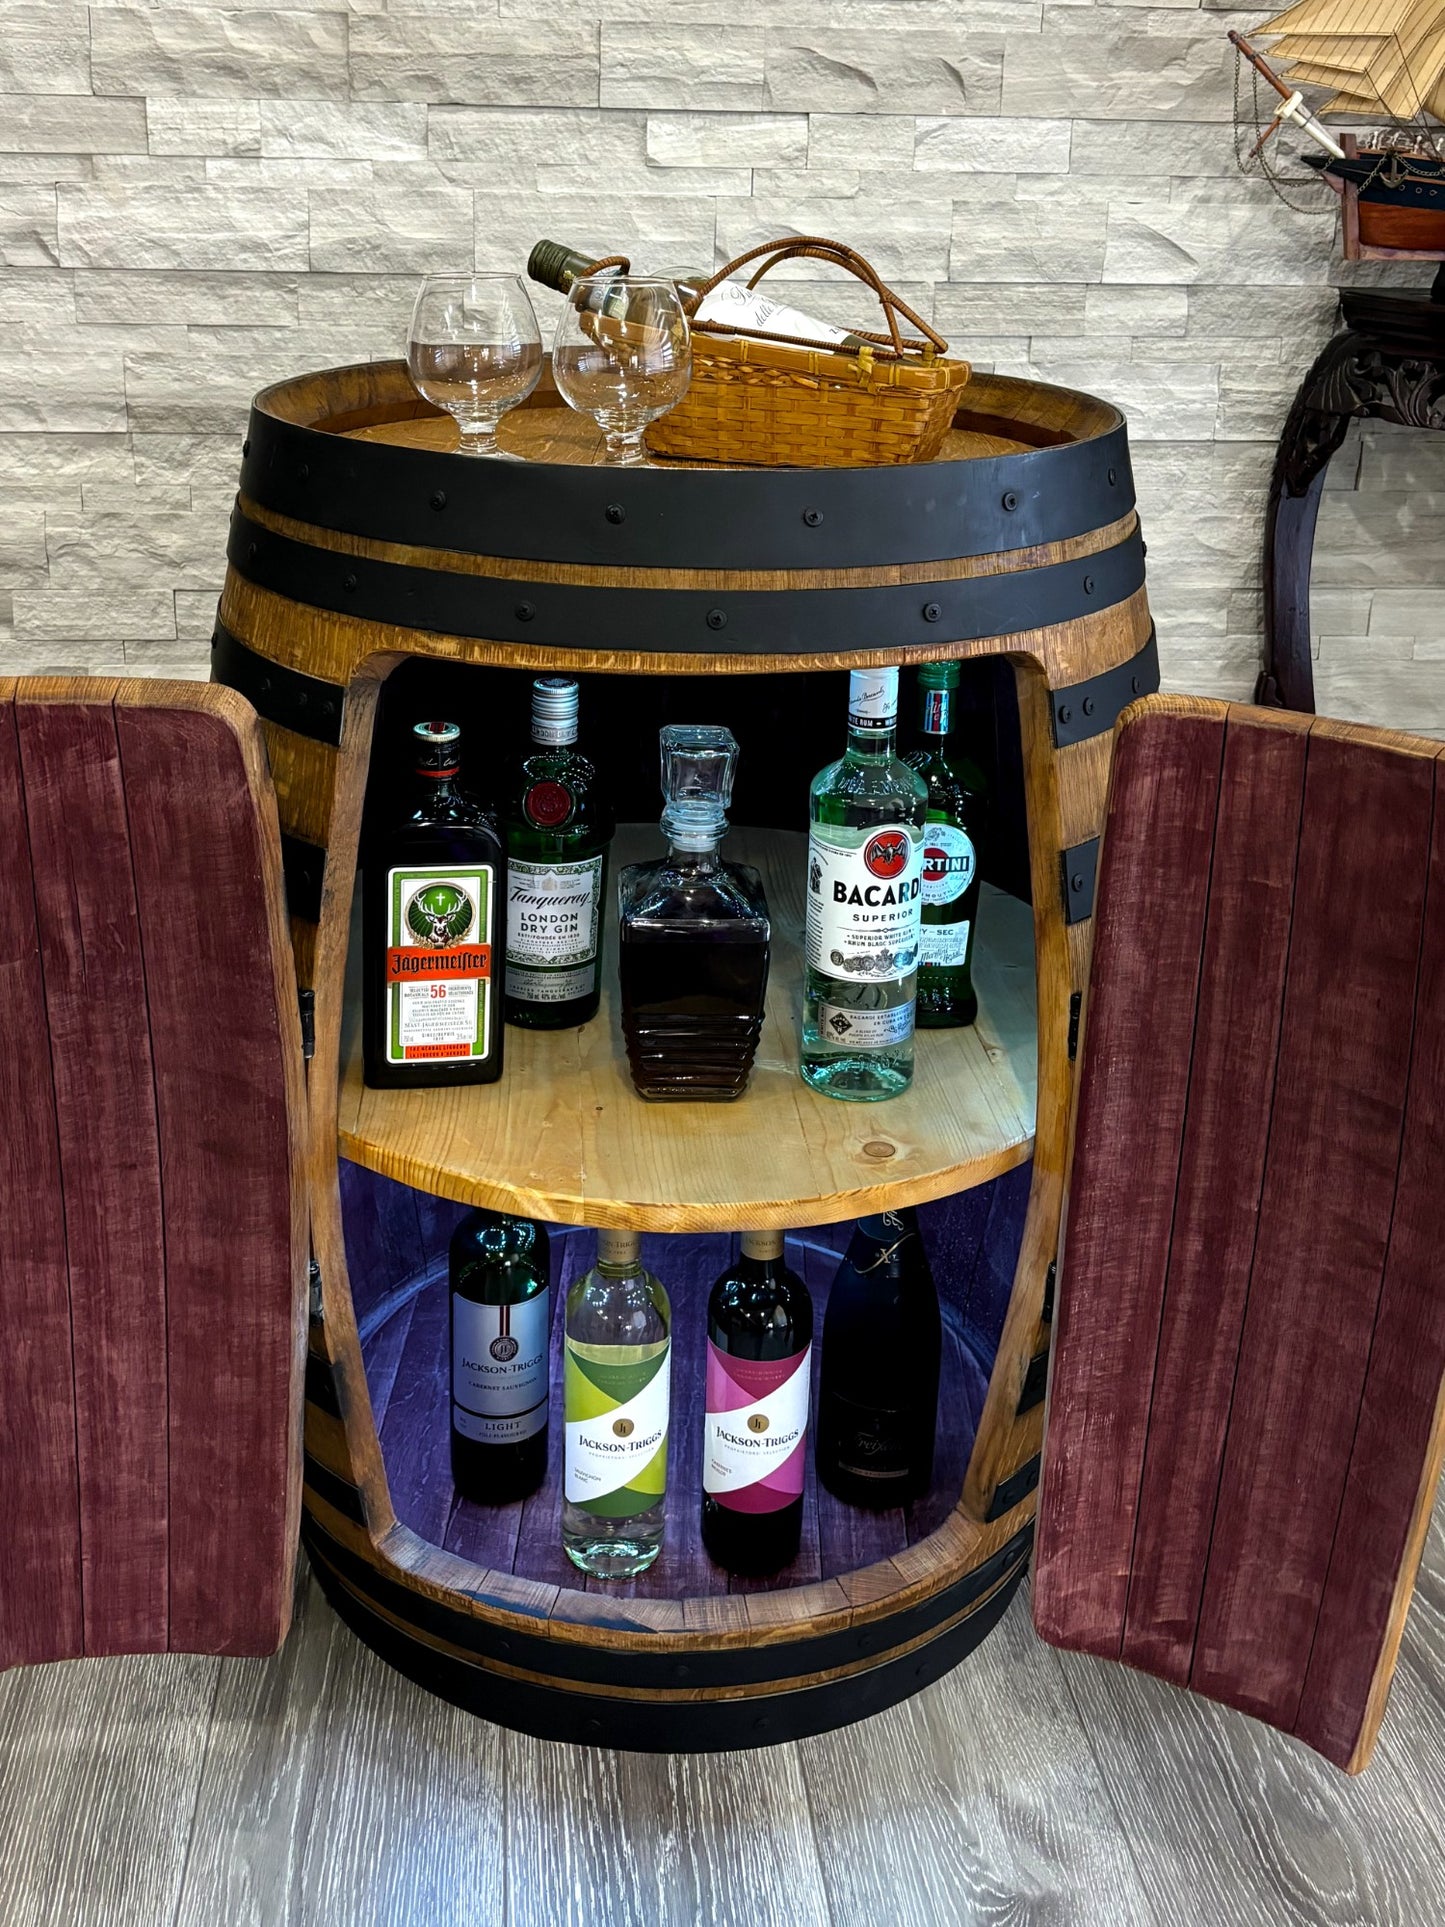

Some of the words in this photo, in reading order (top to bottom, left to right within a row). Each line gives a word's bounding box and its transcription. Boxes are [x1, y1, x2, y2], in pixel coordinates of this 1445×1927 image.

[924, 857, 967, 871] RTINI
[509, 886, 592, 910] Tanqueray
[521, 912, 578, 923] LONDON
[852, 908, 913, 922] SUPERIOR
[520, 922, 548, 934] DRY
[554, 923, 578, 934] GIN
[430, 984, 447, 999] 56
[462, 1352, 544, 1374] JACKSON-TRIGGS
[485, 1420, 521, 1431] LIGHT
[579, 1429, 662, 1453] JACKSON-TRIGGS
[716, 1426, 799, 1448] JACKSON-TRIGGS
